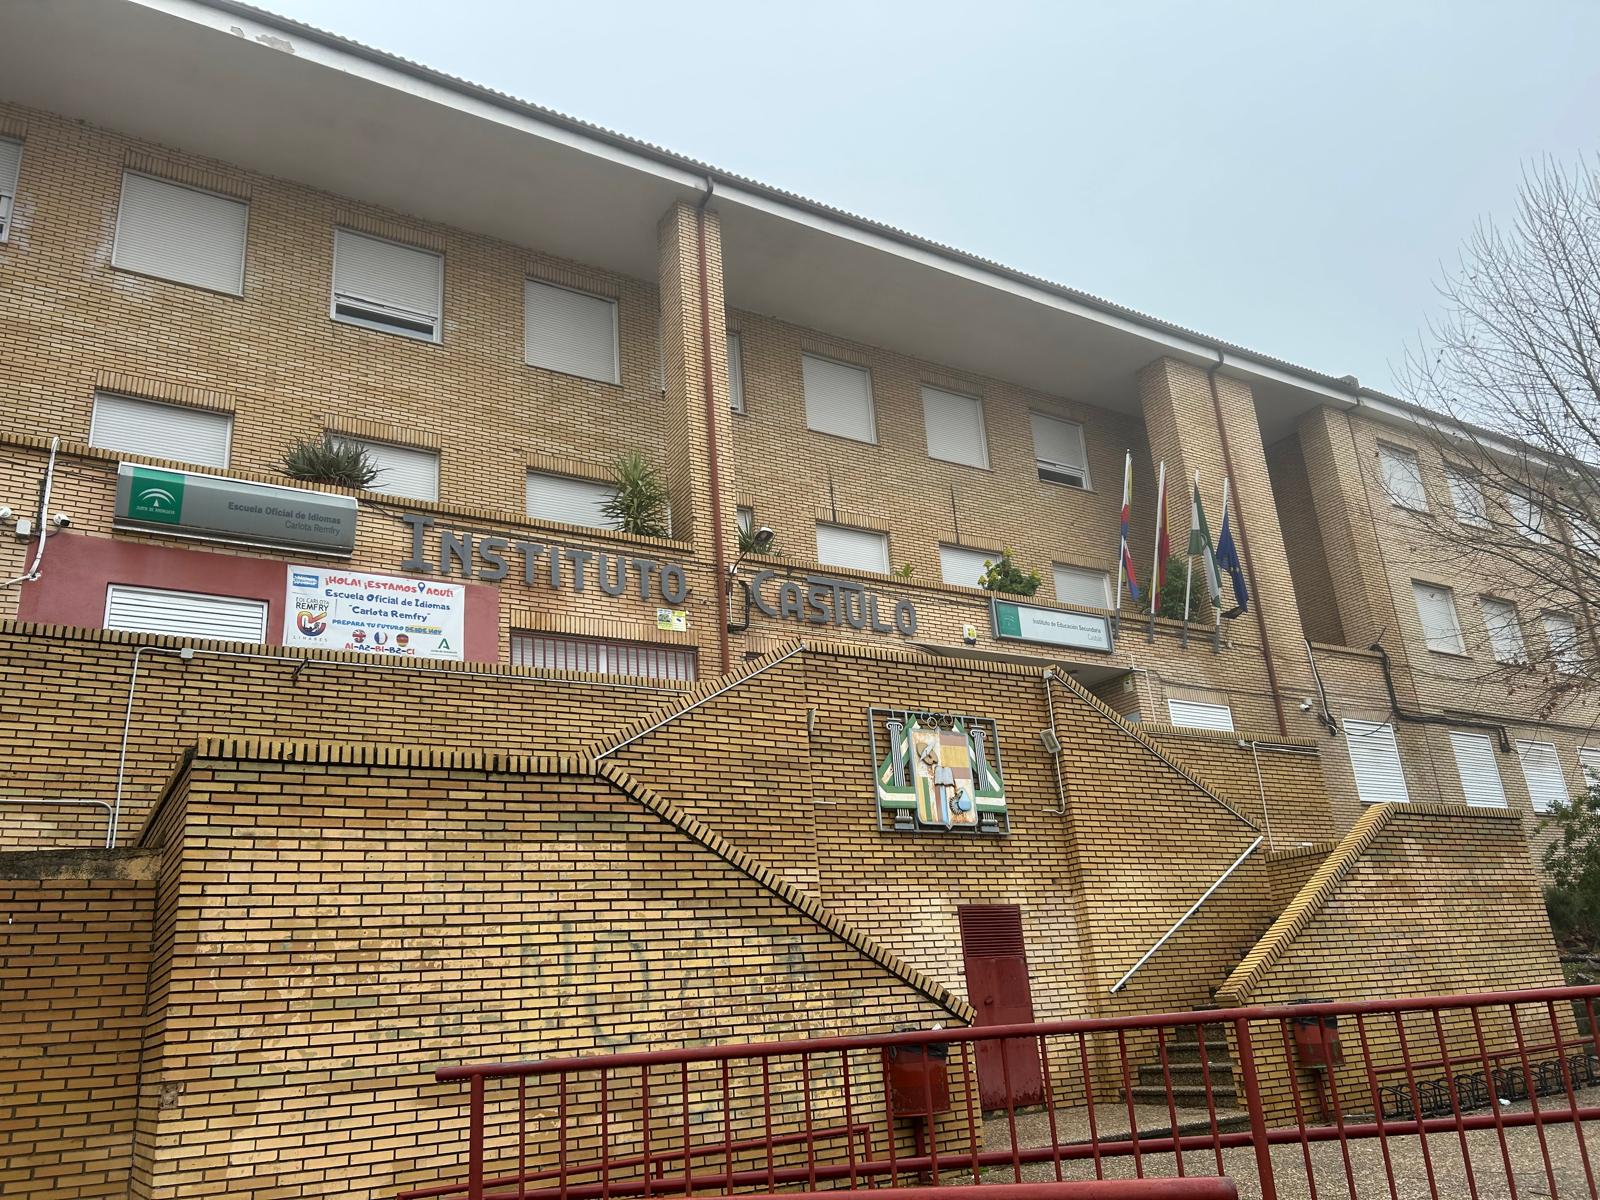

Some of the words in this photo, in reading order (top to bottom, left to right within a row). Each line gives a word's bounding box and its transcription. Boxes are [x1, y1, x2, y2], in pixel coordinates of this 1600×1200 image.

[228, 501, 263, 514] Escuela
[264, 506, 294, 518] Oficial
[295, 511, 306, 519] de
[308, 513, 341, 525] Idiomas
[285, 520, 312, 532] Carlota
[314, 525, 341, 536] Remfry
[401, 513, 687, 604] INSTITUTO
[325, 575, 361, 586] ¡HOLA!
[364, 580, 417, 593] ¡ESTAMOS
[295, 602, 329, 611] REMFRY
[325, 589, 364, 601] Escuela
[366, 594, 399, 605] Oficial
[401, 598, 413, 607] de
[414, 598, 451, 611] Idiomas
[332, 619, 365, 628] PREPARA
[377, 623, 404, 631] FUTURO
